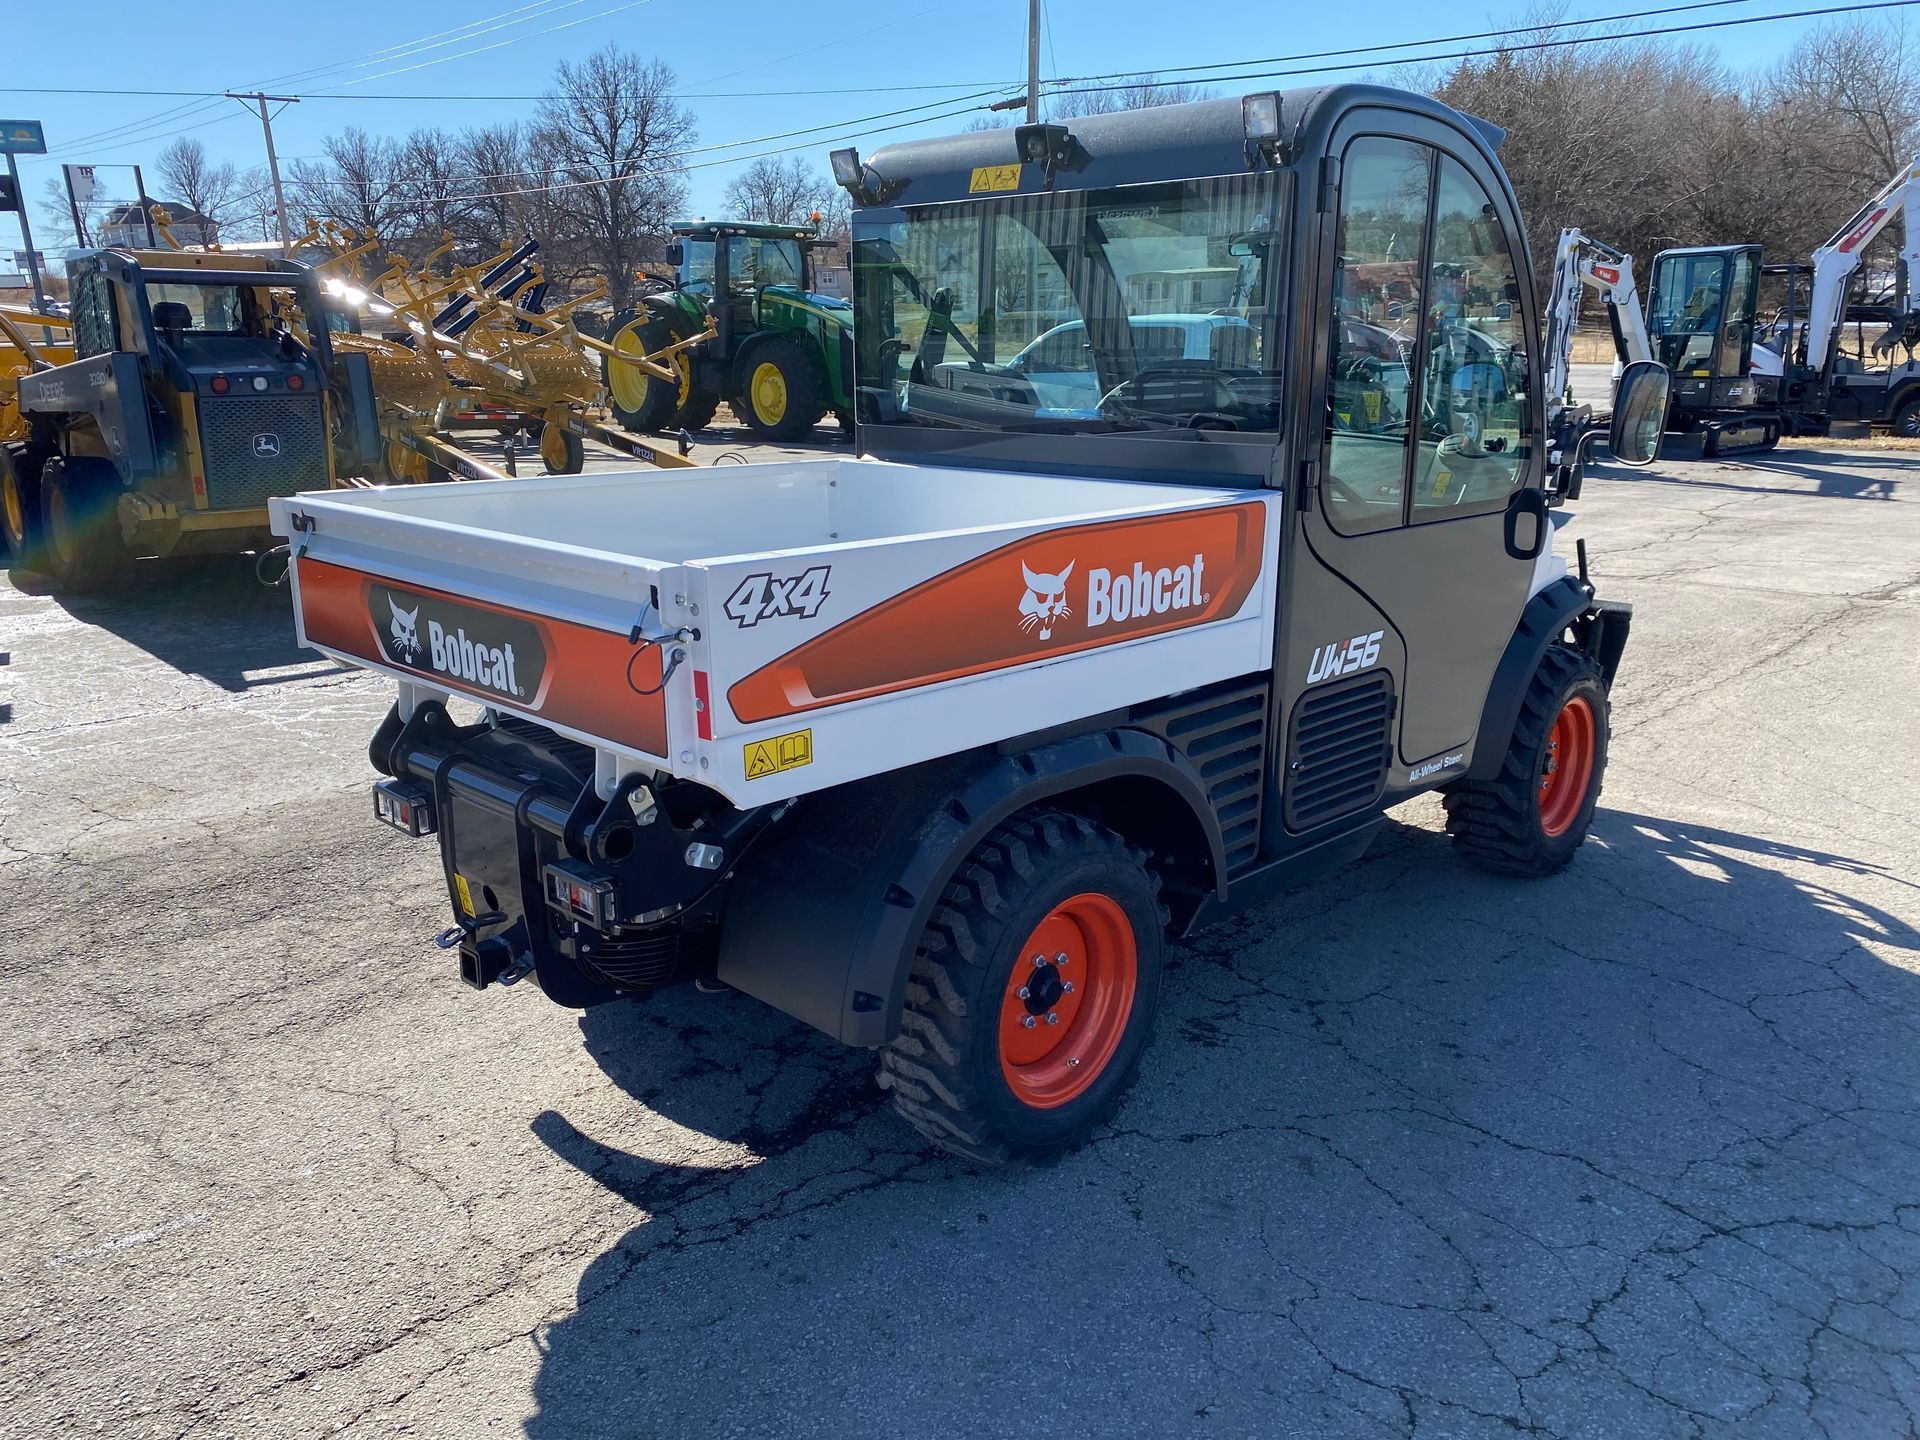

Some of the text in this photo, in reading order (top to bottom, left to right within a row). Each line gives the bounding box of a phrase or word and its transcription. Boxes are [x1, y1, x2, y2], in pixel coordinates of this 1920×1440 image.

[40, 380, 66, 401] DEERE
[456, 460, 478, 481] VR1224
[632, 444, 655, 461] VR1224
[723, 564, 832, 629] 4x4
[1087, 553, 1205, 628] Bobcat
[427, 619, 519, 696] Bobcat
[1306, 630, 1384, 684] UW56
[1409, 753, 1463, 783] All-Wheel Steer
